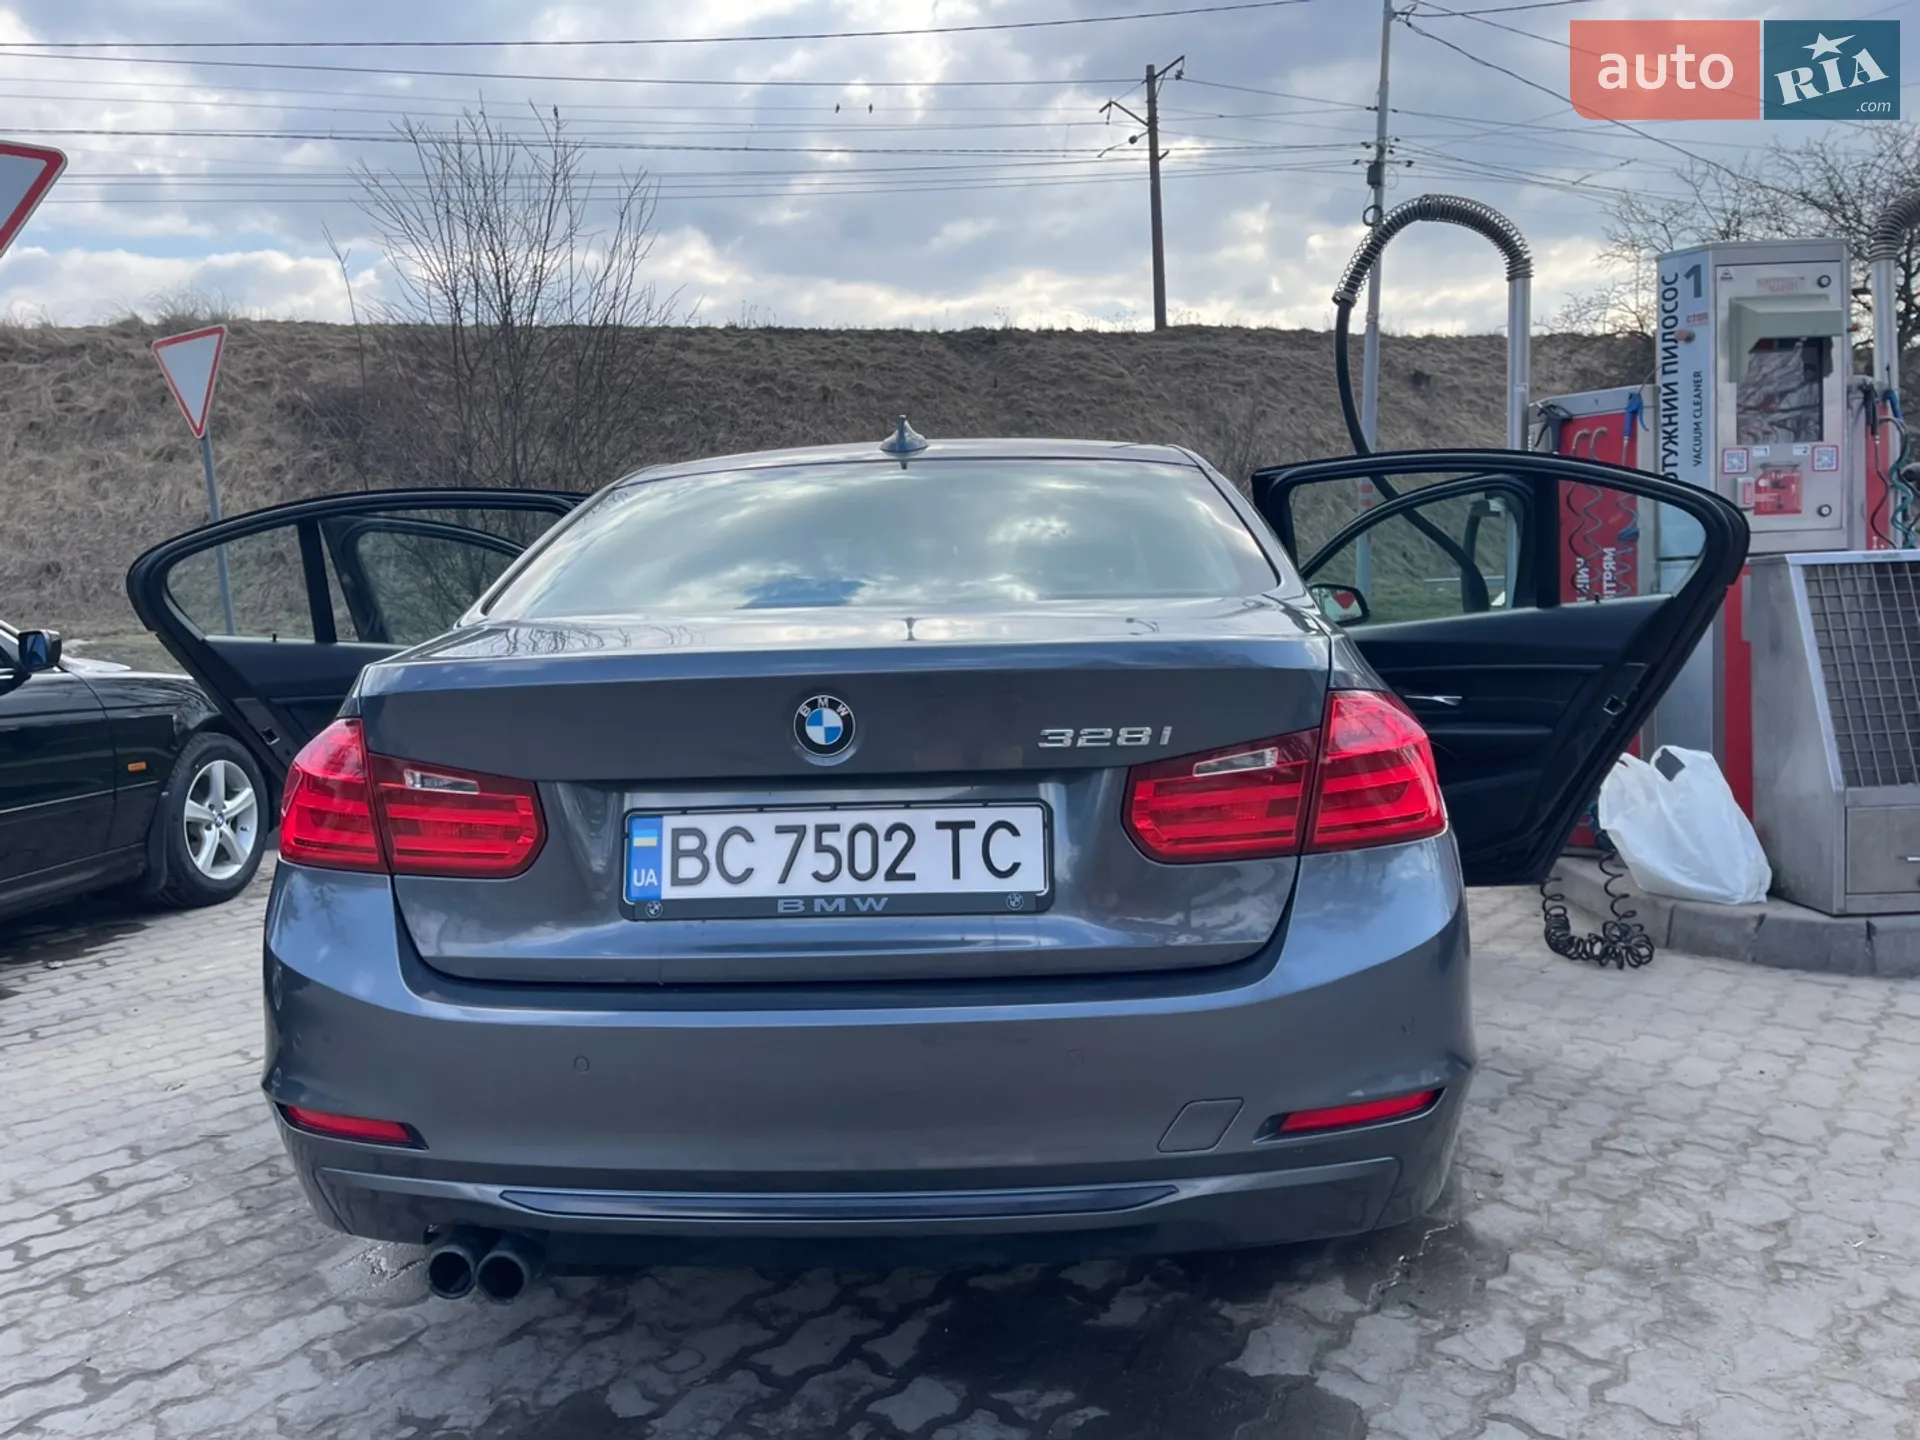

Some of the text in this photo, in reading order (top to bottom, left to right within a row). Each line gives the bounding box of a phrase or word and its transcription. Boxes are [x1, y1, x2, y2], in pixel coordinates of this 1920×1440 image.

[1684, 264, 1702, 298] 1
[1661, 272, 1679, 375] ПИЛОСОС
[1693, 371, 1703, 467] VACUUM CLEANER
[1038, 726, 1172, 748] 328i
[670, 820, 1021, 887] BC 7502 TC
[633, 869, 658, 887] UA
[777, 896, 888, 912] BMW
